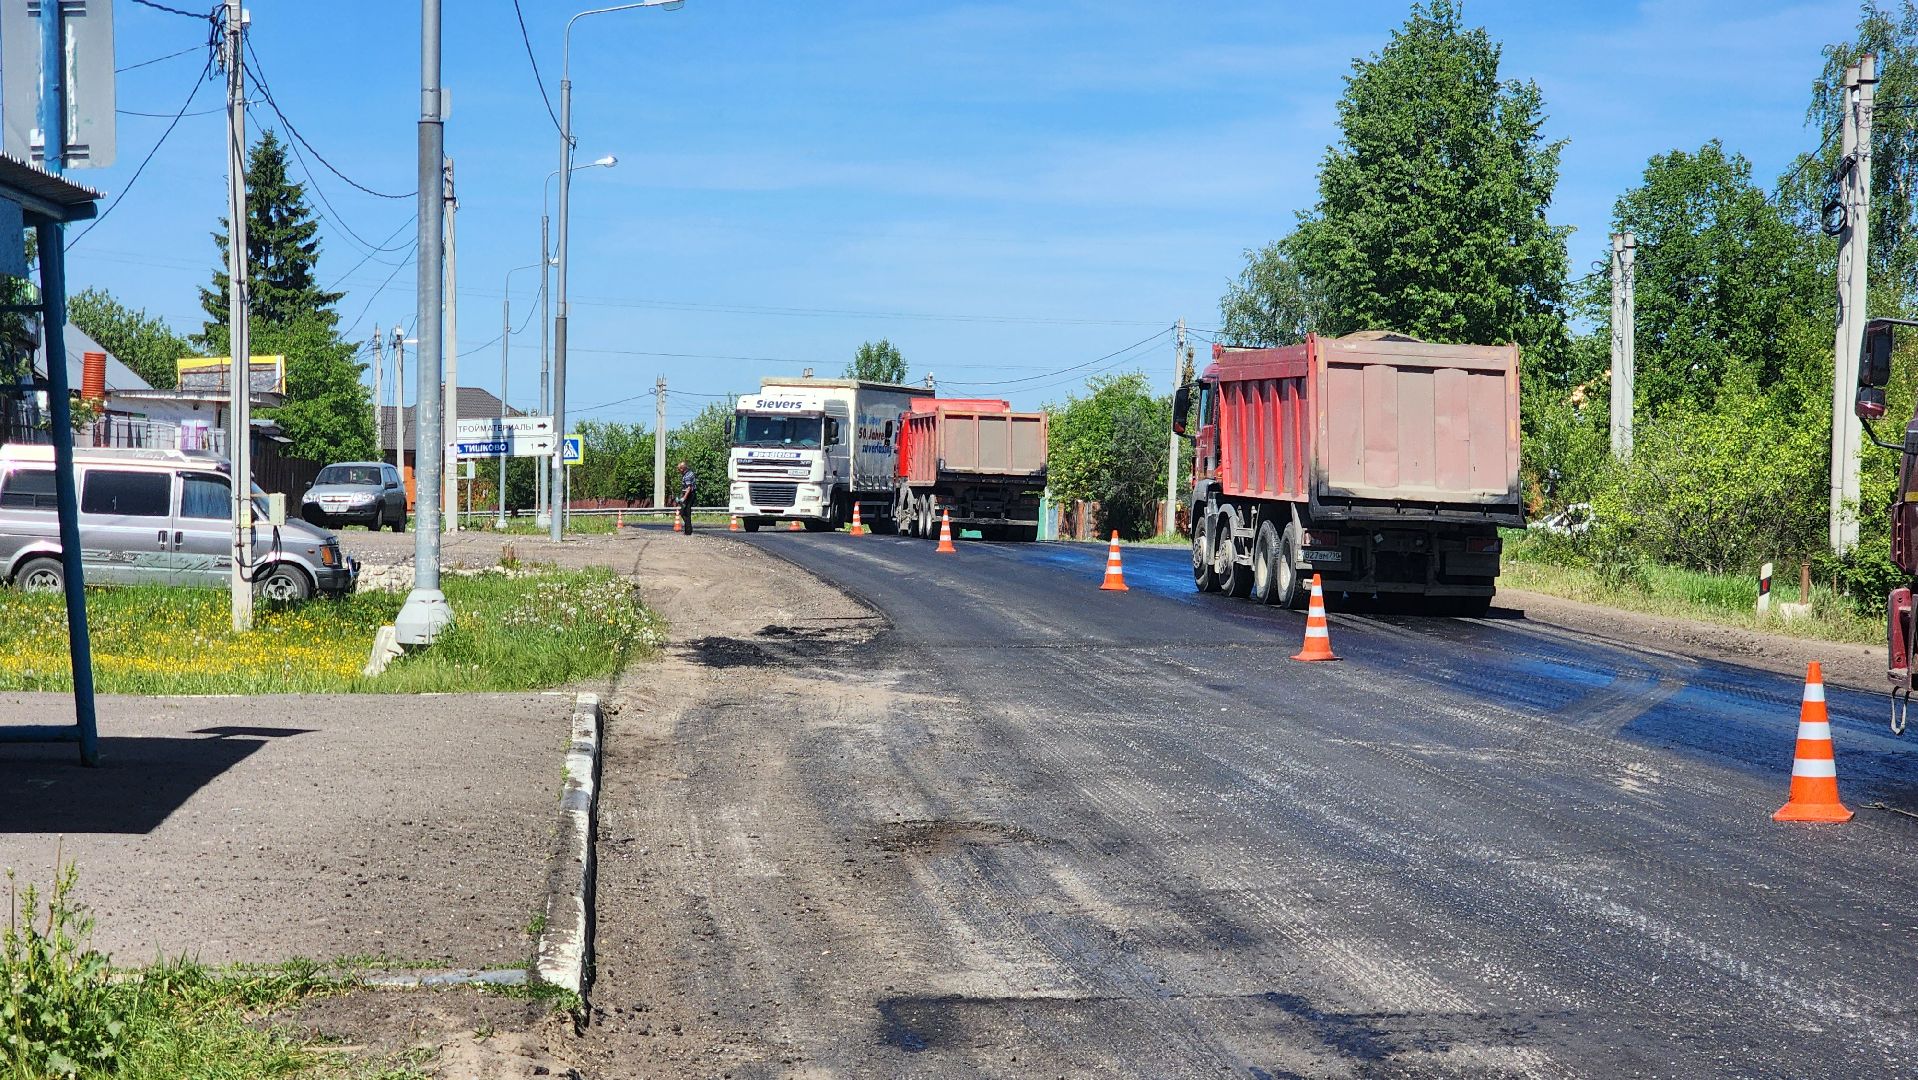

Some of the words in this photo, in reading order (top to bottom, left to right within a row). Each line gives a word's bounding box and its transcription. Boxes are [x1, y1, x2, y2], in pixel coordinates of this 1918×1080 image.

[756, 399, 803, 409] Sievers
[458, 423, 534, 432] ТРОЙМАТЕРИАЛЫ
[464, 444, 506, 453] ТИШКОВО
